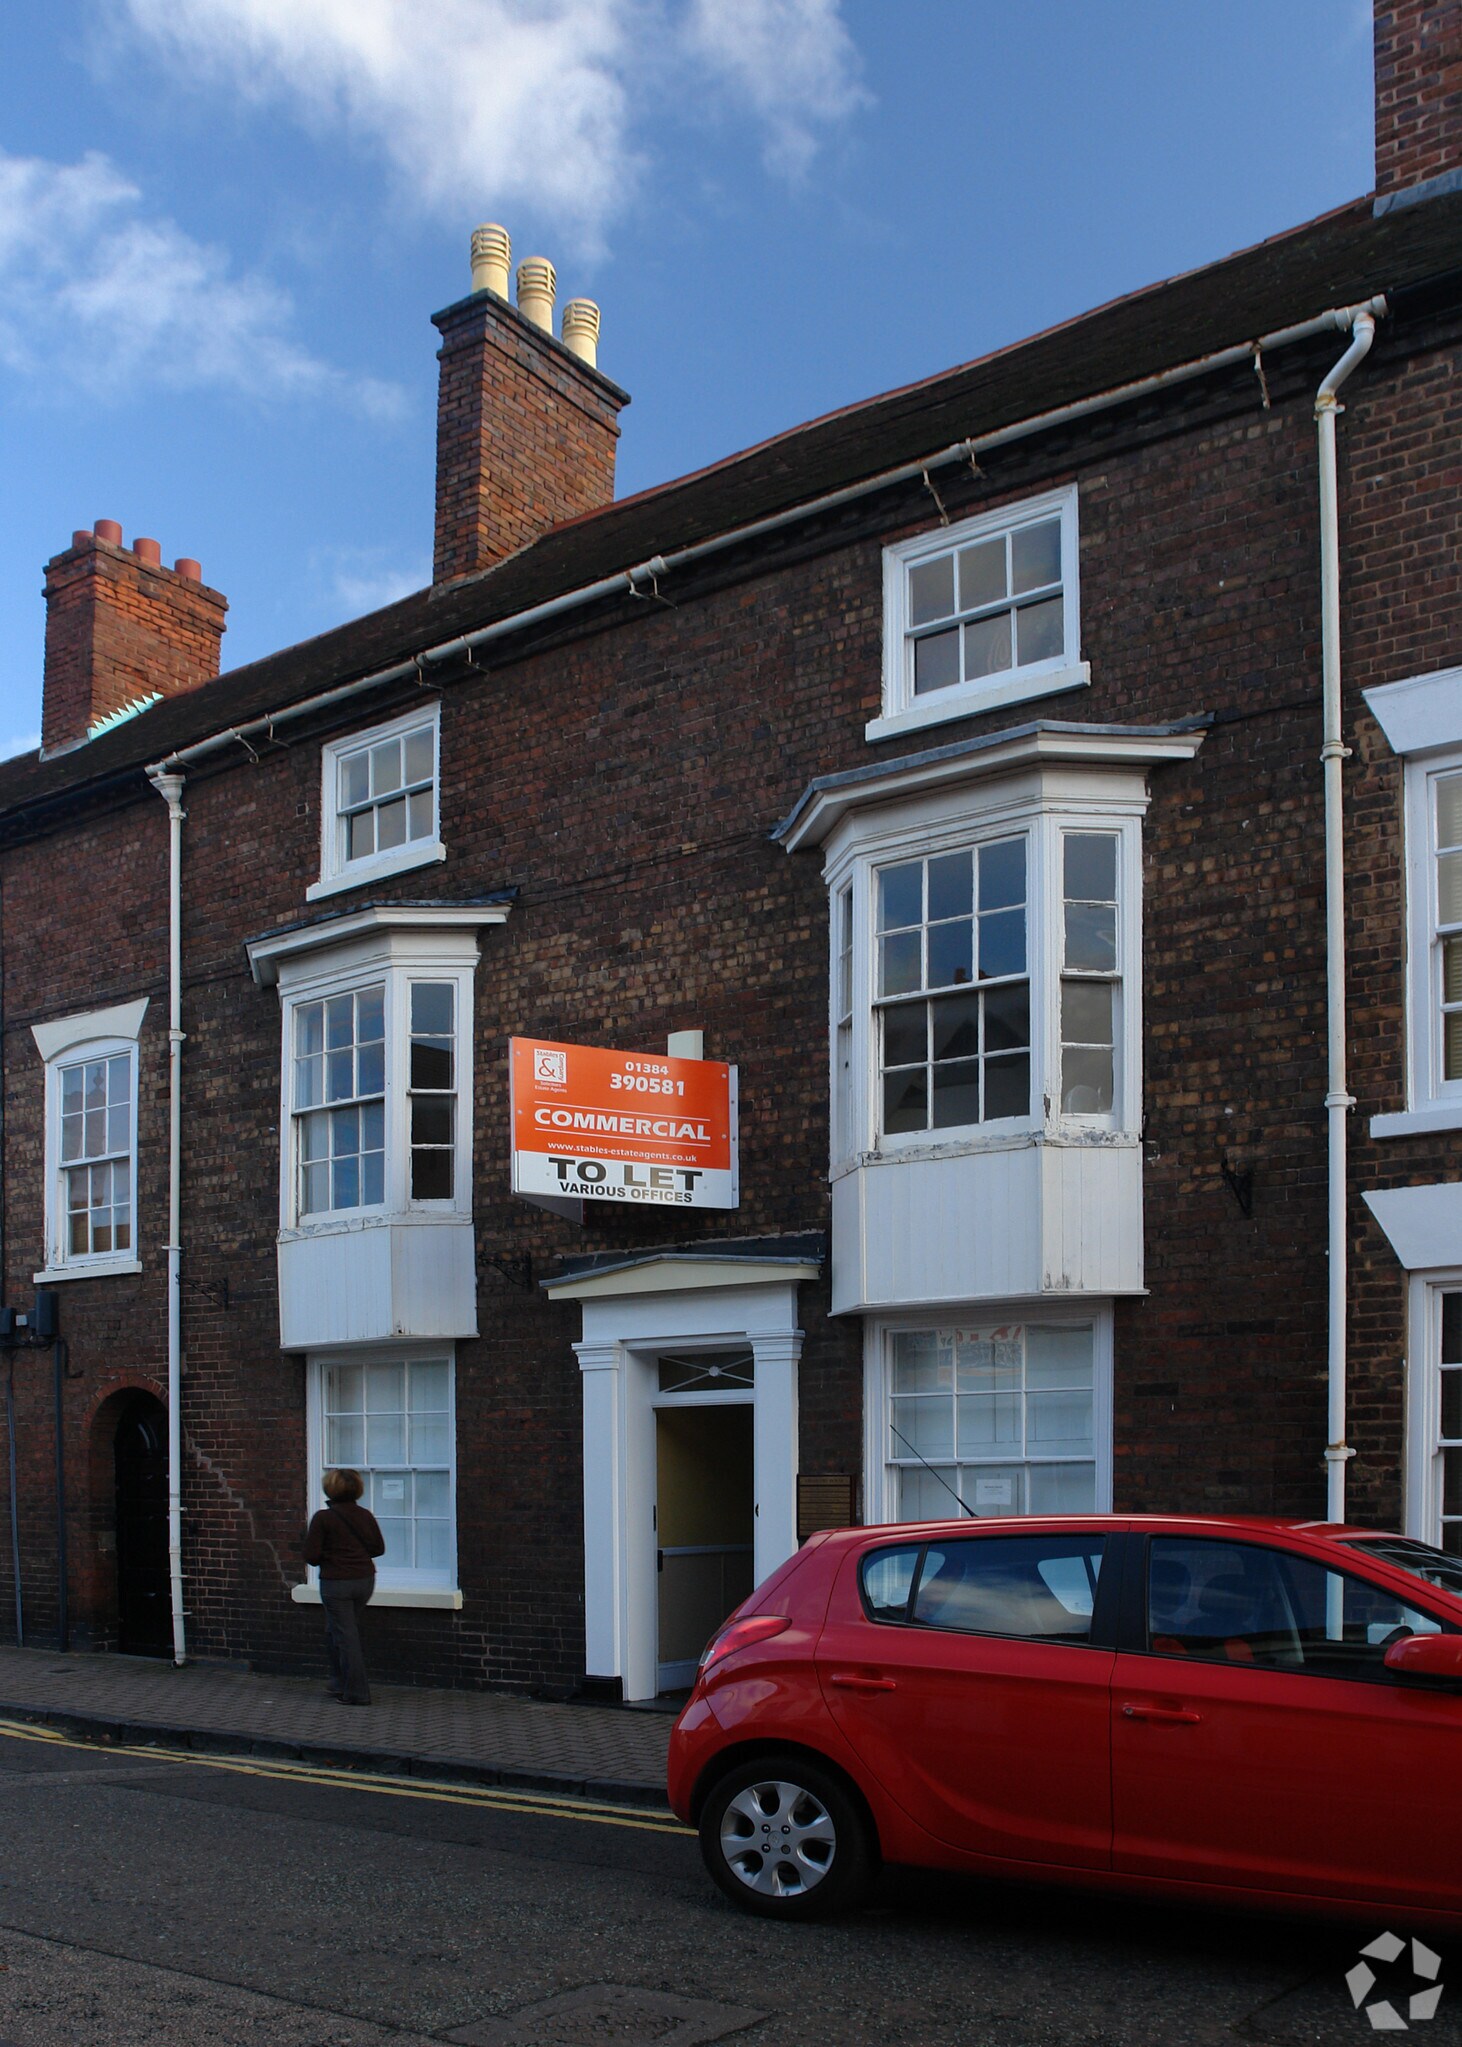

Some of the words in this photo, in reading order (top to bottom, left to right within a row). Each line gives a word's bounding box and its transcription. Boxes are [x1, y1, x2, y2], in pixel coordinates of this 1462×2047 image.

[539, 1058, 556, 1078] &
[625, 1062, 669, 1075] 01384
[610, 1073, 685, 1096] 390581
[534, 1108, 711, 1141] COMMERCIAL
[547, 1142, 697, 1162] www.stables-estateagents.co.uk
[548, 1157, 607, 1183] TO
[624, 1165, 703, 1191] LET
[560, 1182, 626, 1198] VARIOUS
[630, 1188, 693, 1203] OFFICES
